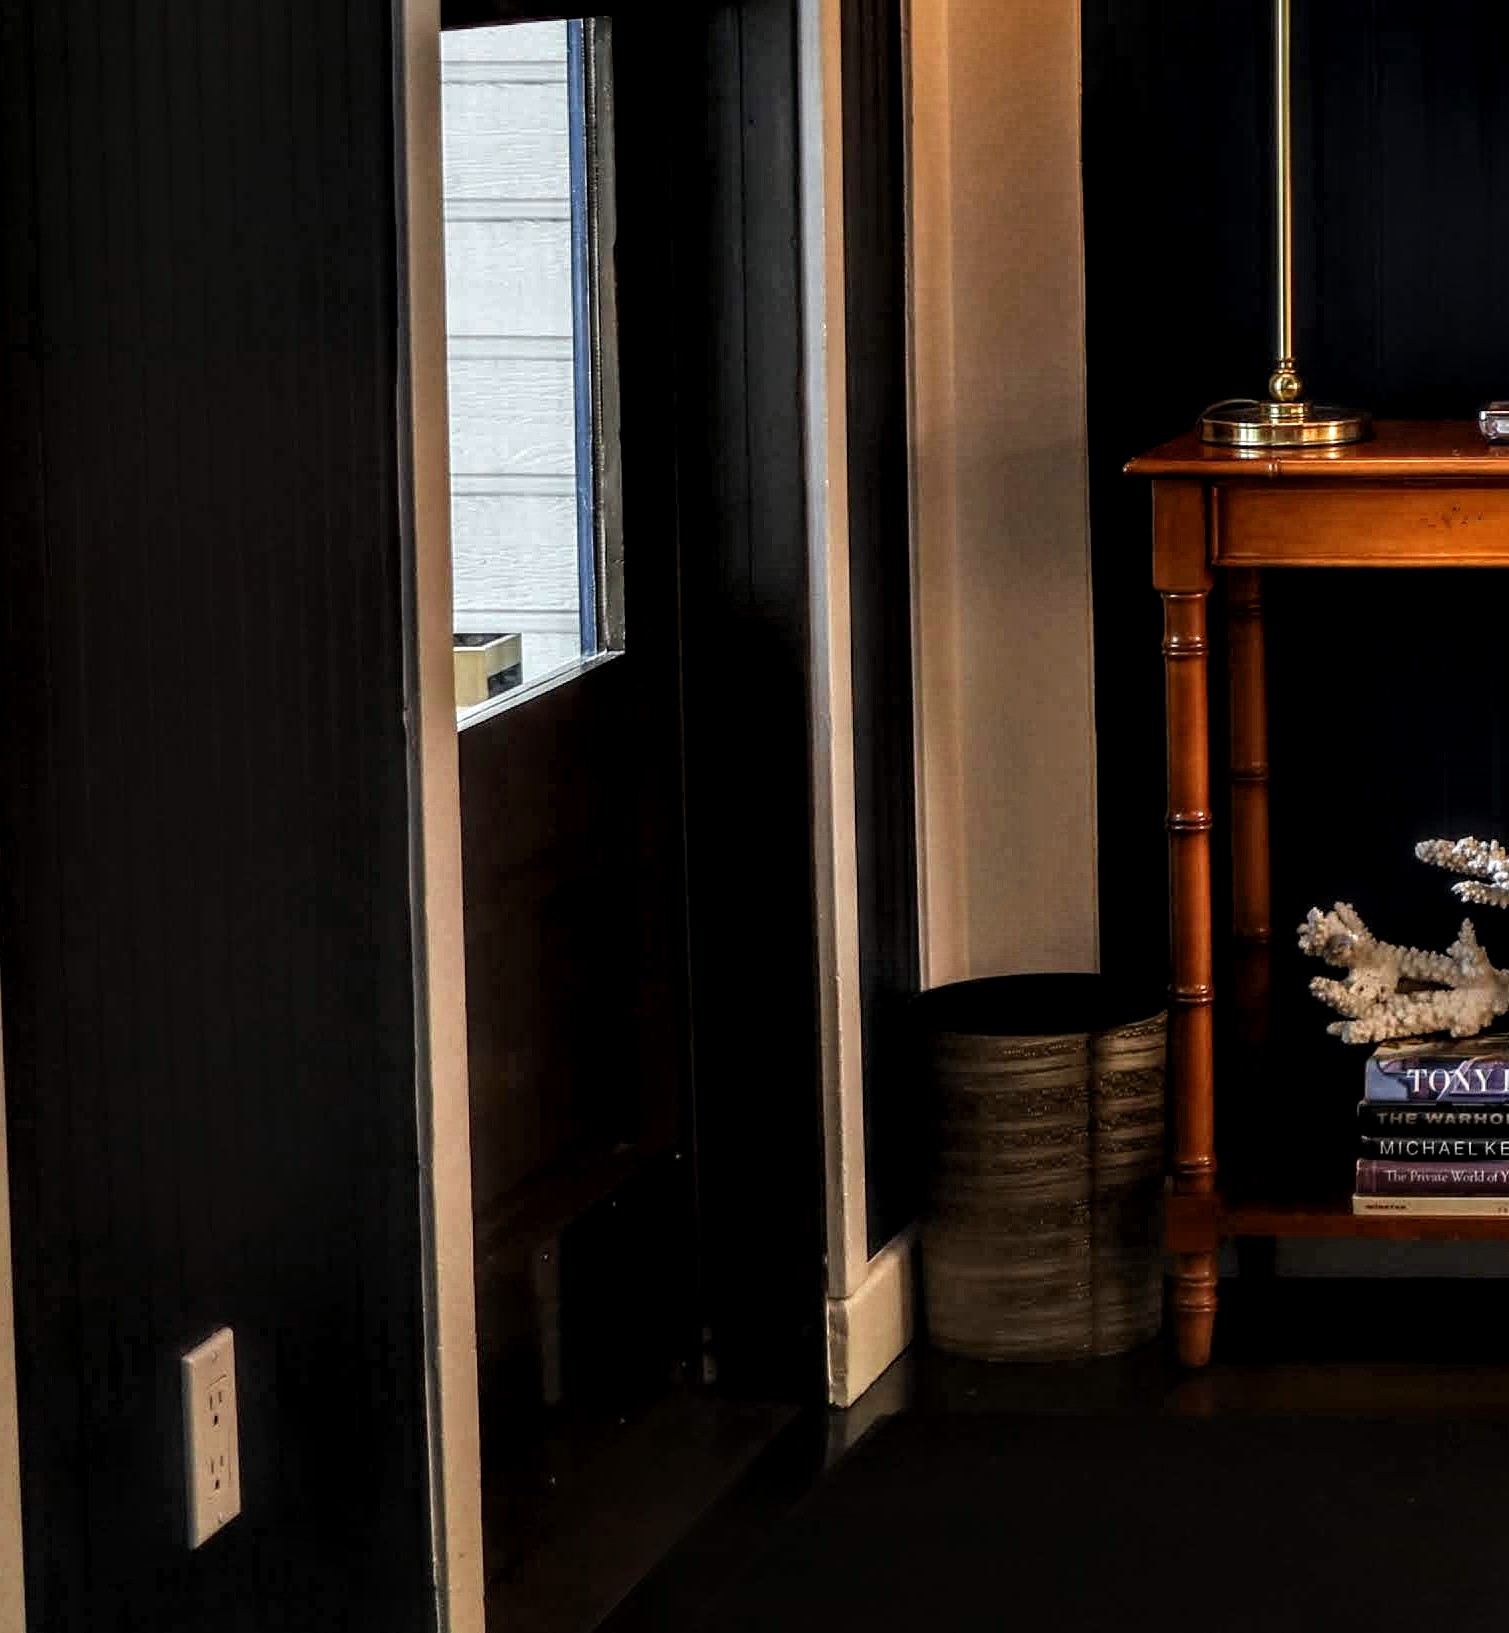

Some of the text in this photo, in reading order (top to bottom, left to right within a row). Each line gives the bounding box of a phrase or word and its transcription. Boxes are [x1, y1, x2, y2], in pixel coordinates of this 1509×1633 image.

[1406, 1068, 1493, 1093] TONY
[1377, 1112, 1417, 1125] THE
[1380, 1140, 1478, 1156] MICHAEL
[1387, 1169, 1407, 1183] The
[1410, 1170, 1448, 1183] Private
[1450, 1169, 1484, 1183] World
[1487, 1169, 1498, 1183] of
